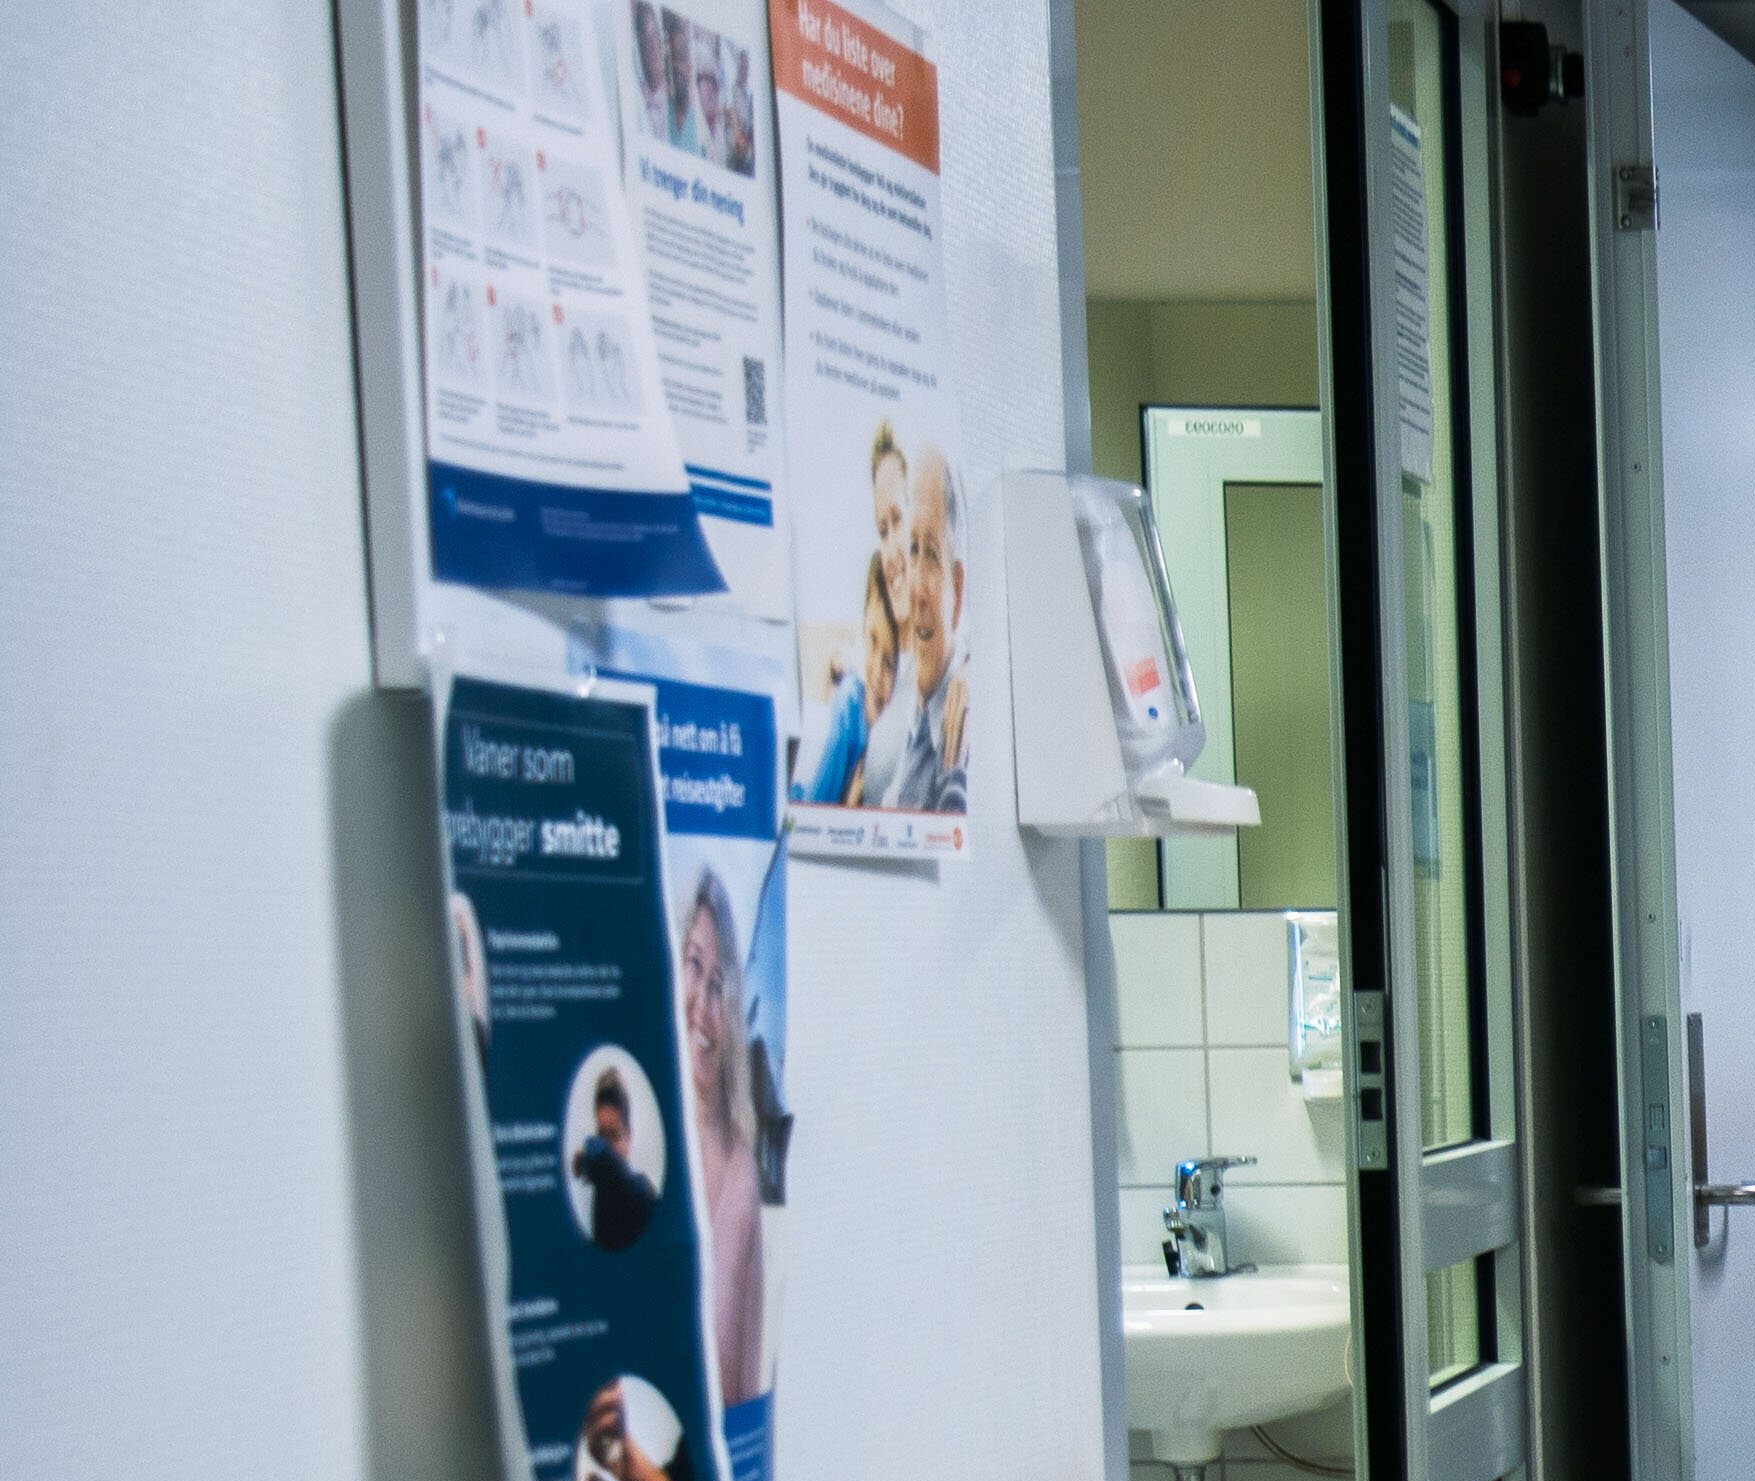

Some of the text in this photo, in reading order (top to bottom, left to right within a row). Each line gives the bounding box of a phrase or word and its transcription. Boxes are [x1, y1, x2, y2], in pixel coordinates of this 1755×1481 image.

[798, 1, 896, 88] Har du liste over
[802, 58, 904, 141] medisinene dine?
[463, 724, 576, 784] Vaner som
[446, 795, 620, 866] rebygger smitte
